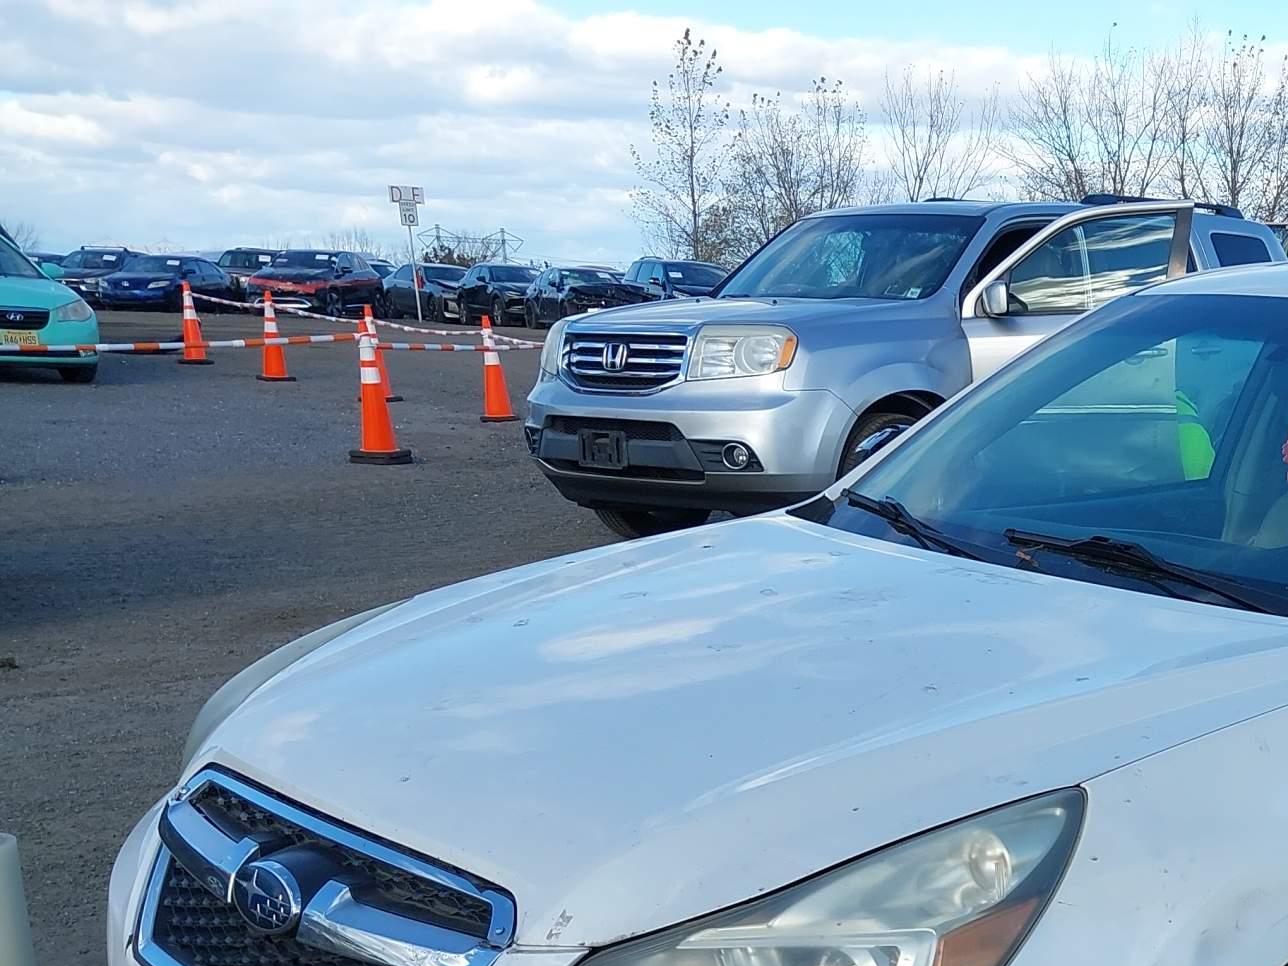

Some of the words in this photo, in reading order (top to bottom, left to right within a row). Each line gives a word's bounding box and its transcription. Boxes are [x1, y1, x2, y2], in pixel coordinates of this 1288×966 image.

[391, 186, 402, 203] D
[412, 187, 421, 204] E
[404, 213, 415, 223] 10
